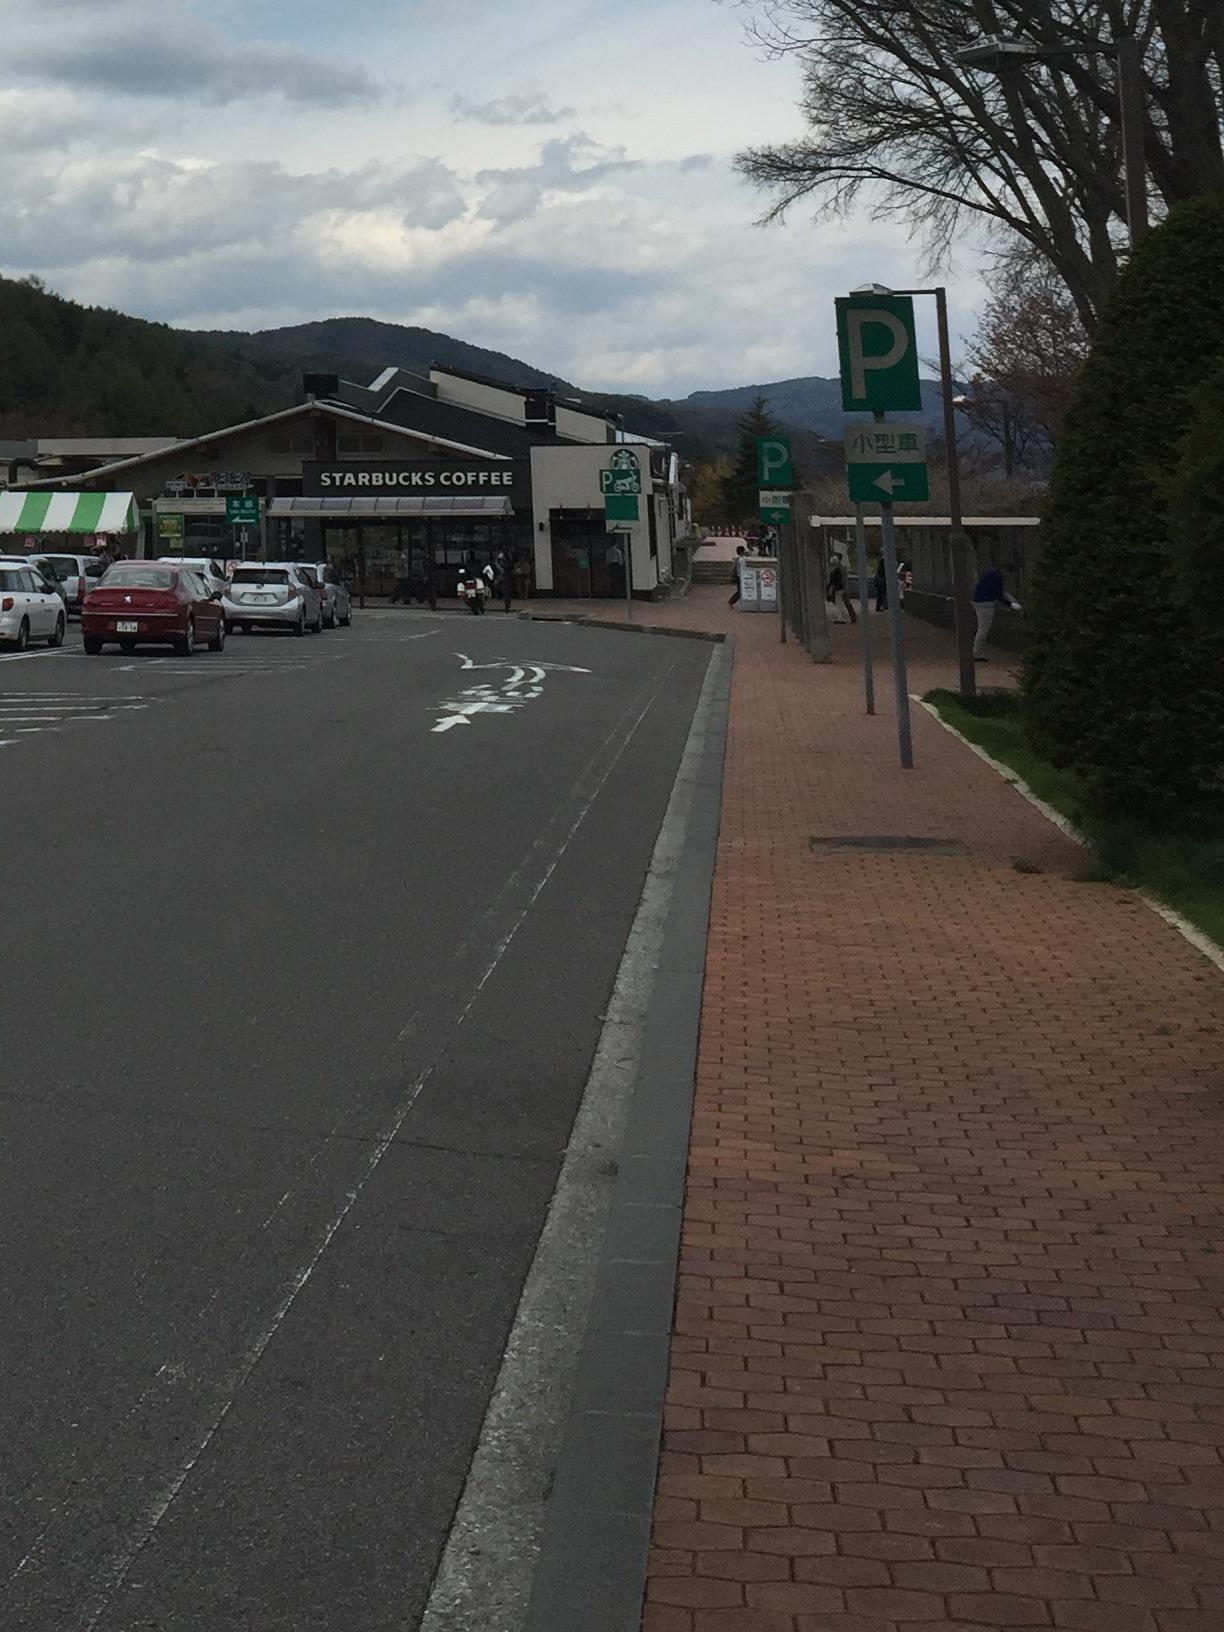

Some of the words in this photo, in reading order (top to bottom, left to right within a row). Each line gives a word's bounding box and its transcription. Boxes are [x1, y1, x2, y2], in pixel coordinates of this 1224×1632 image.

[846, 309, 910, 400] P
[852, 432, 920, 455] 小型車
[762, 442, 789, 481] P
[320, 472, 436, 486] STARBUCKS
[439, 471, 513, 486] COFFEE
[602, 471, 613, 493] P
